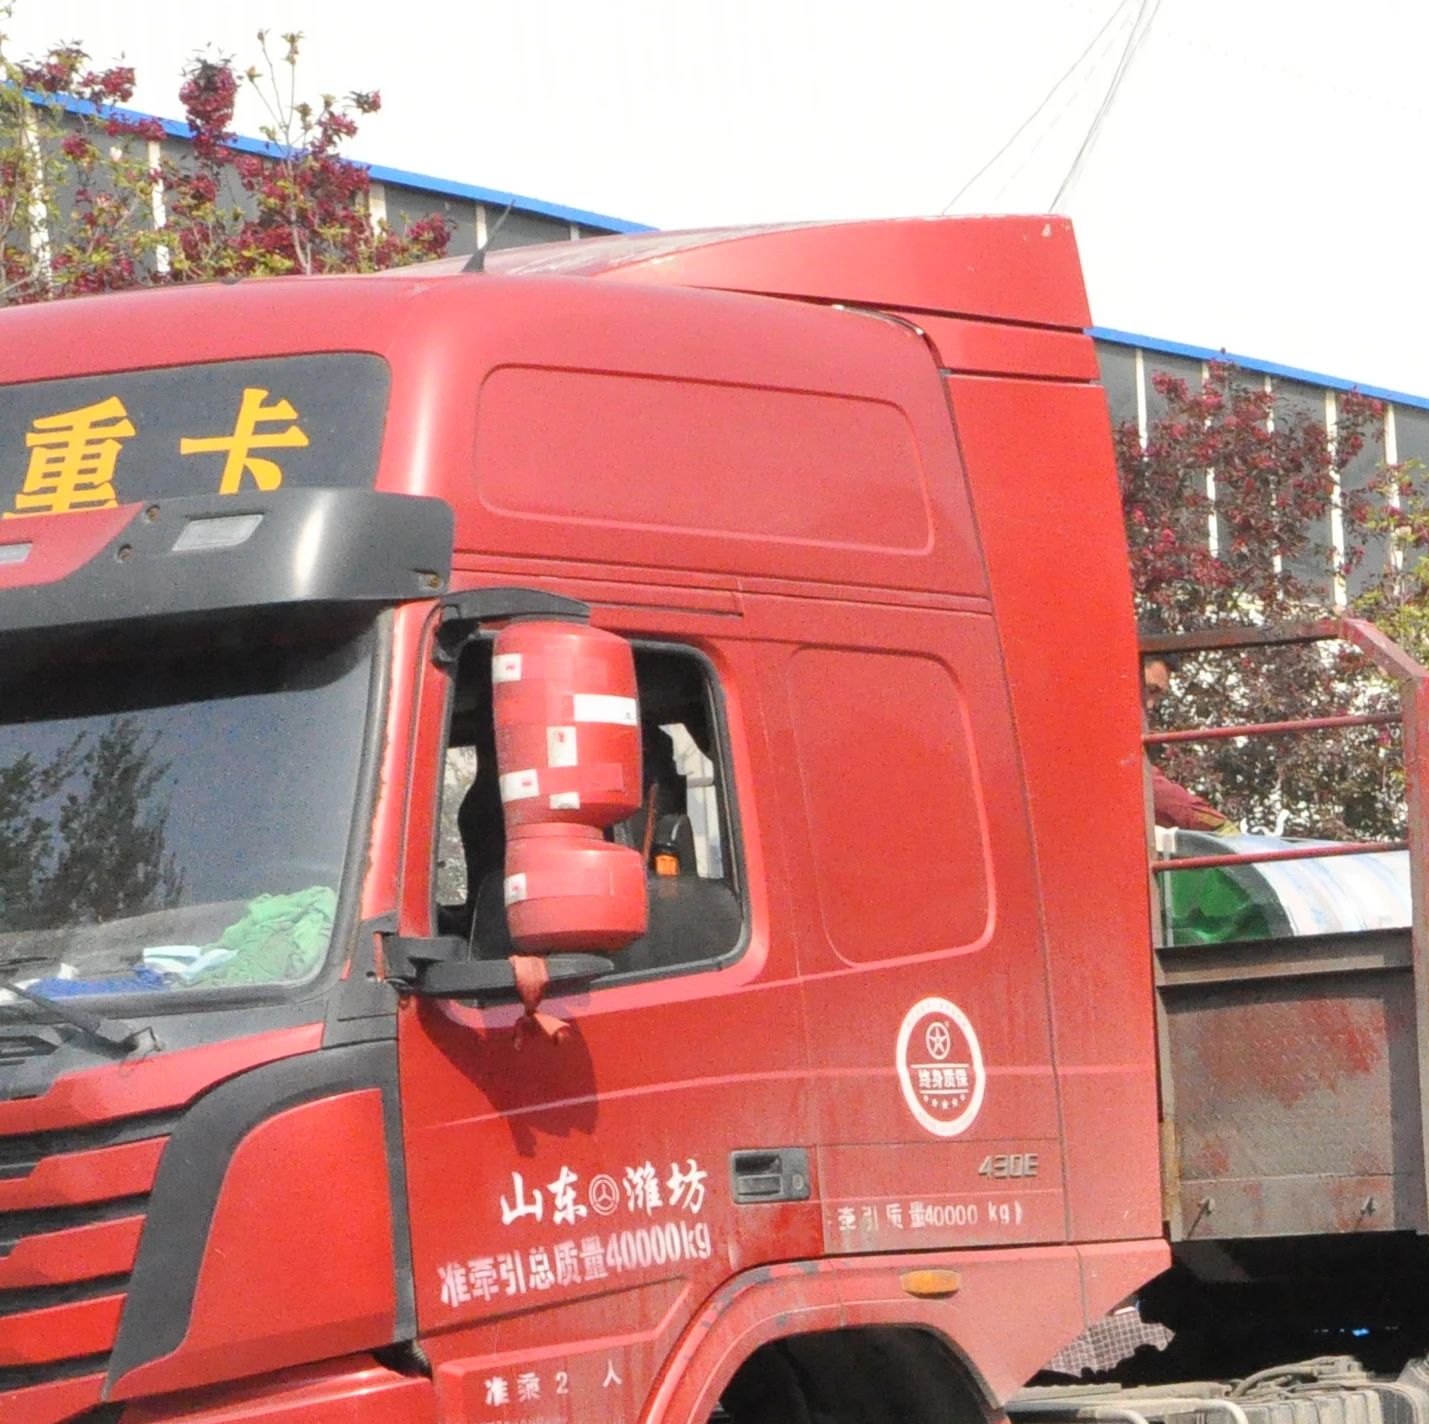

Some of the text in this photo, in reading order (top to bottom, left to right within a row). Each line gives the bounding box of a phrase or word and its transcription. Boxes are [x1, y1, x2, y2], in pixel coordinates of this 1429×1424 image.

[2, 387, 310, 519] 重卡
[918, 1068, 968, 1088] 终身质保
[978, 1153, 1038, 1179] 430E
[500, 1159, 708, 1225] 山东 潍坊
